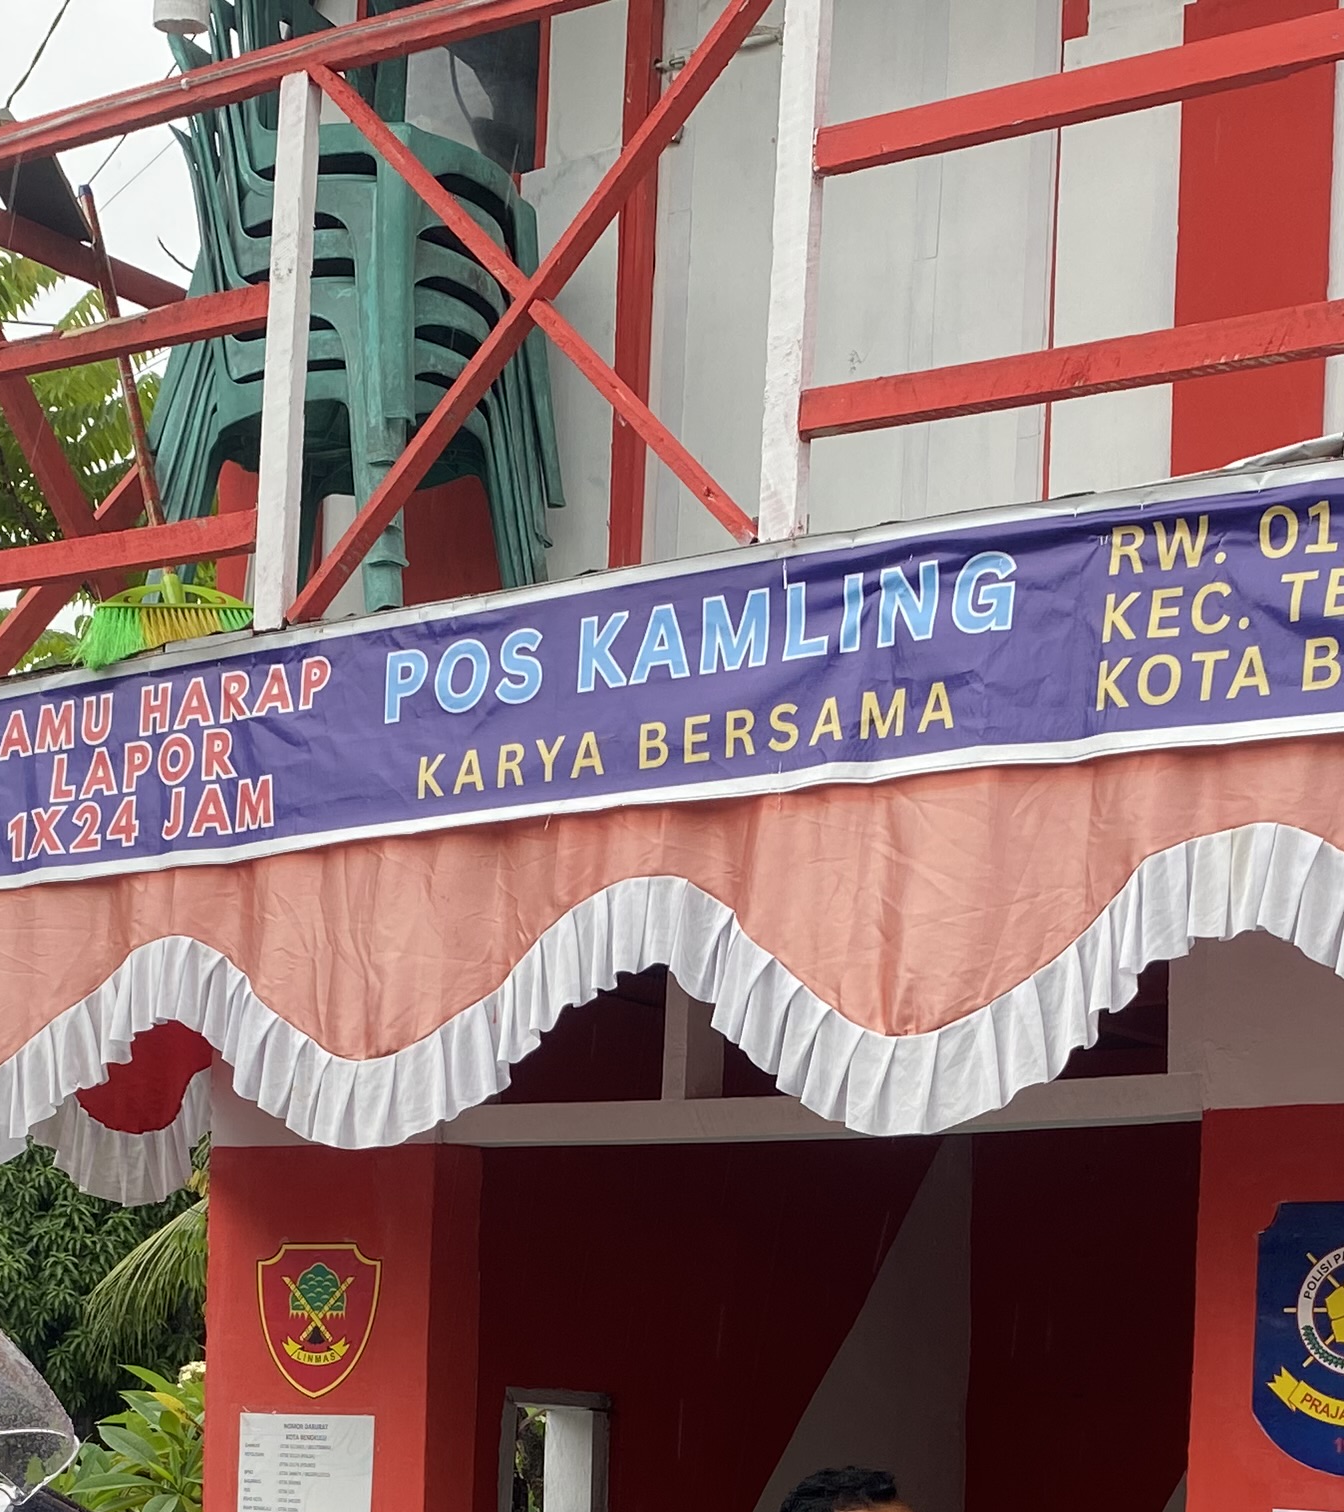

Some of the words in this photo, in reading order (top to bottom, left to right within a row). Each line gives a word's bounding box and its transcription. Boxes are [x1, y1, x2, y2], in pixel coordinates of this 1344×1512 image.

[1109, 514, 1227, 576] RW.
[382, 635, 545, 724] POS
[576, 550, 1018, 693] KAMLING
[1100, 578, 1250, 643] KEC.
[140, 654, 333, 734] HARAP
[1096, 643, 1271, 713] KOTA
[52, 729, 233, 803] LAPOR
[417, 731, 605, 800] KARYA
[640, 681, 956, 770] BERSAMA
[6, 804, 140, 863] 1X24
[161, 774, 275, 842] JAM
[1302, 1258, 1334, 1300] POLISI
[297, 1351, 336, 1364] LINMAS
